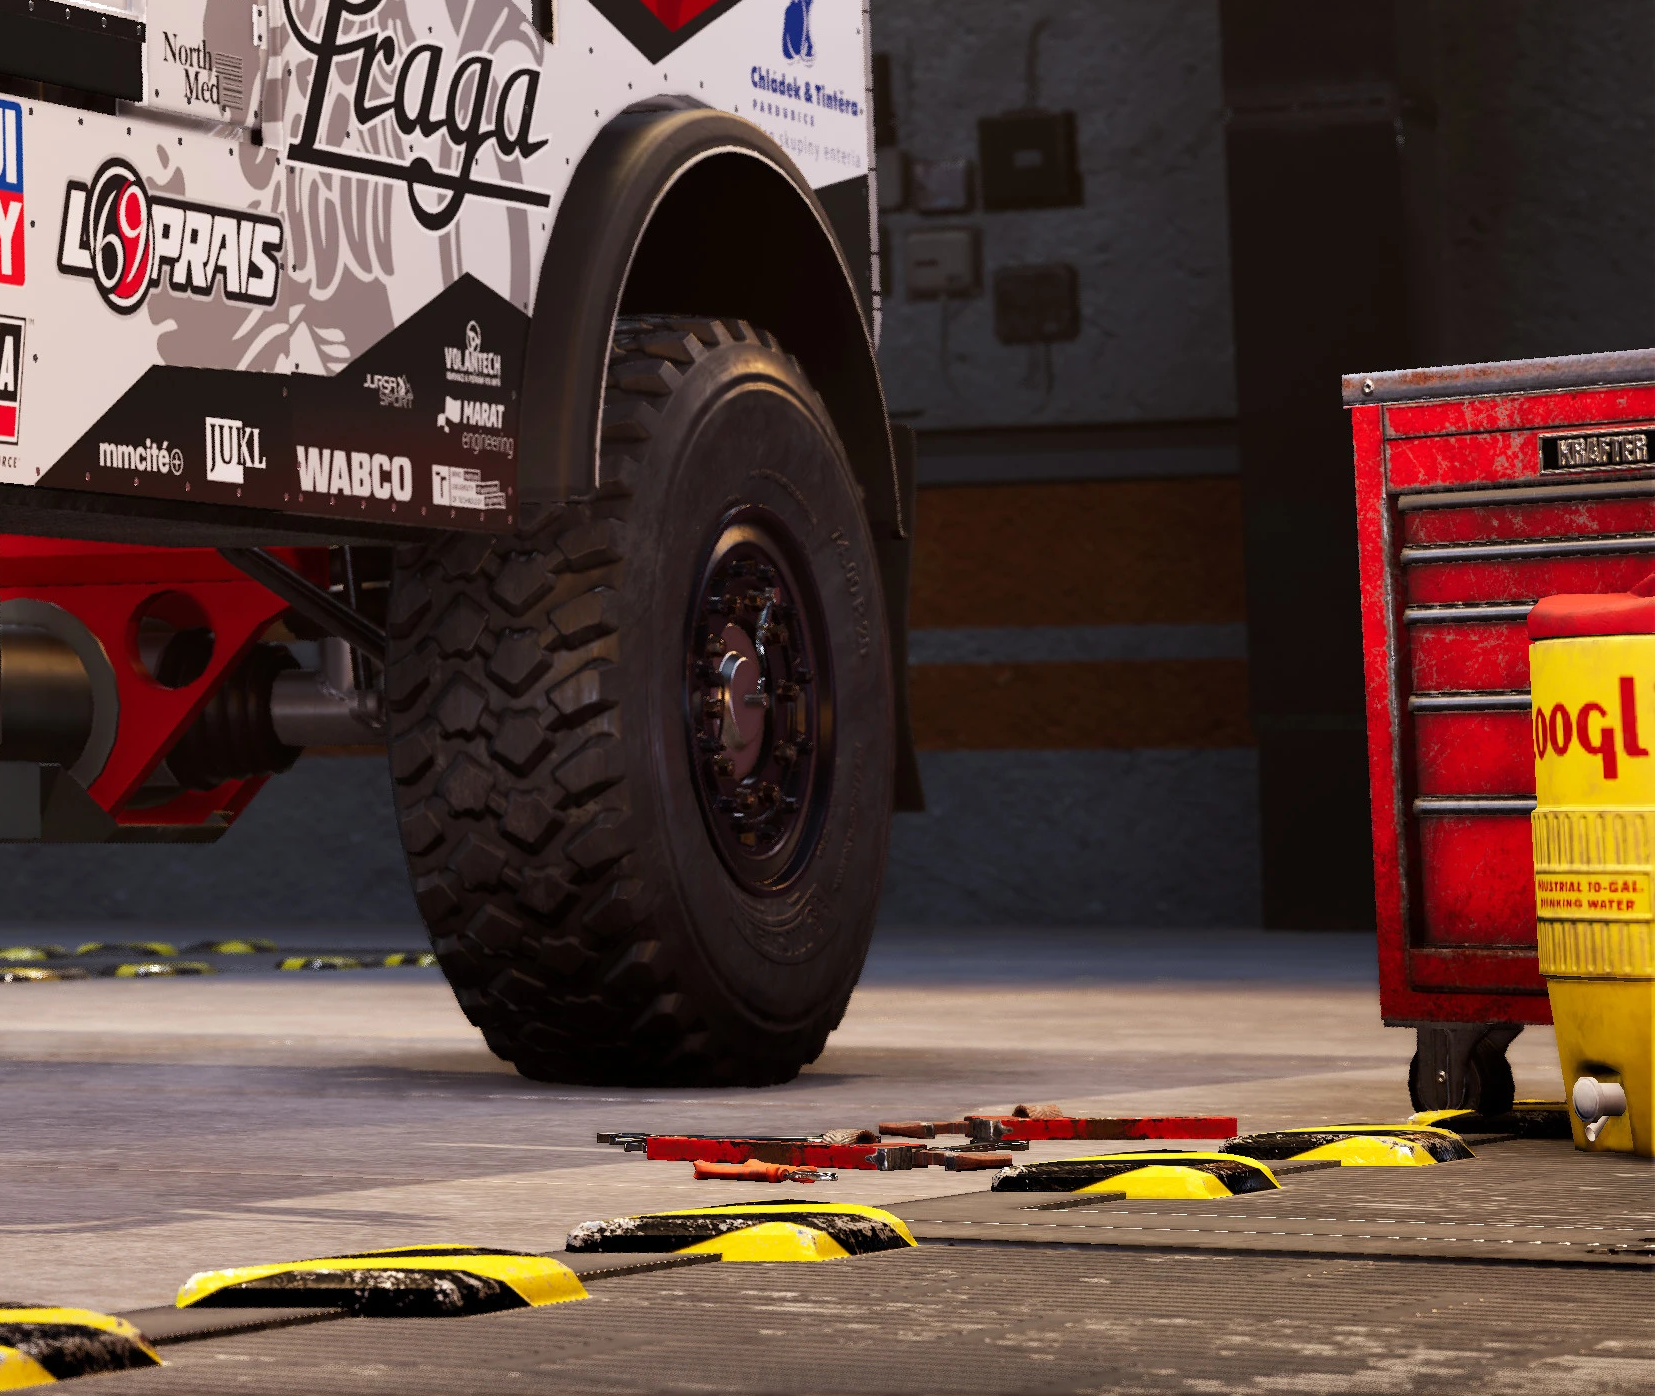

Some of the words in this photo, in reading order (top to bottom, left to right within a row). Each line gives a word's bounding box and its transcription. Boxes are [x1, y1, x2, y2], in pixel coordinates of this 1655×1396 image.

[162, 30, 213, 72] North
[183, 67, 221, 105] Med
[804, 81, 813, 104] &
[463, 399, 505, 429] MARAT
[99, 437, 170, 474] mmcité
[208, 422, 267, 473] JUKL
[296, 445, 412, 502] WABCO
[1588, 899, 1635, 911] WATER
